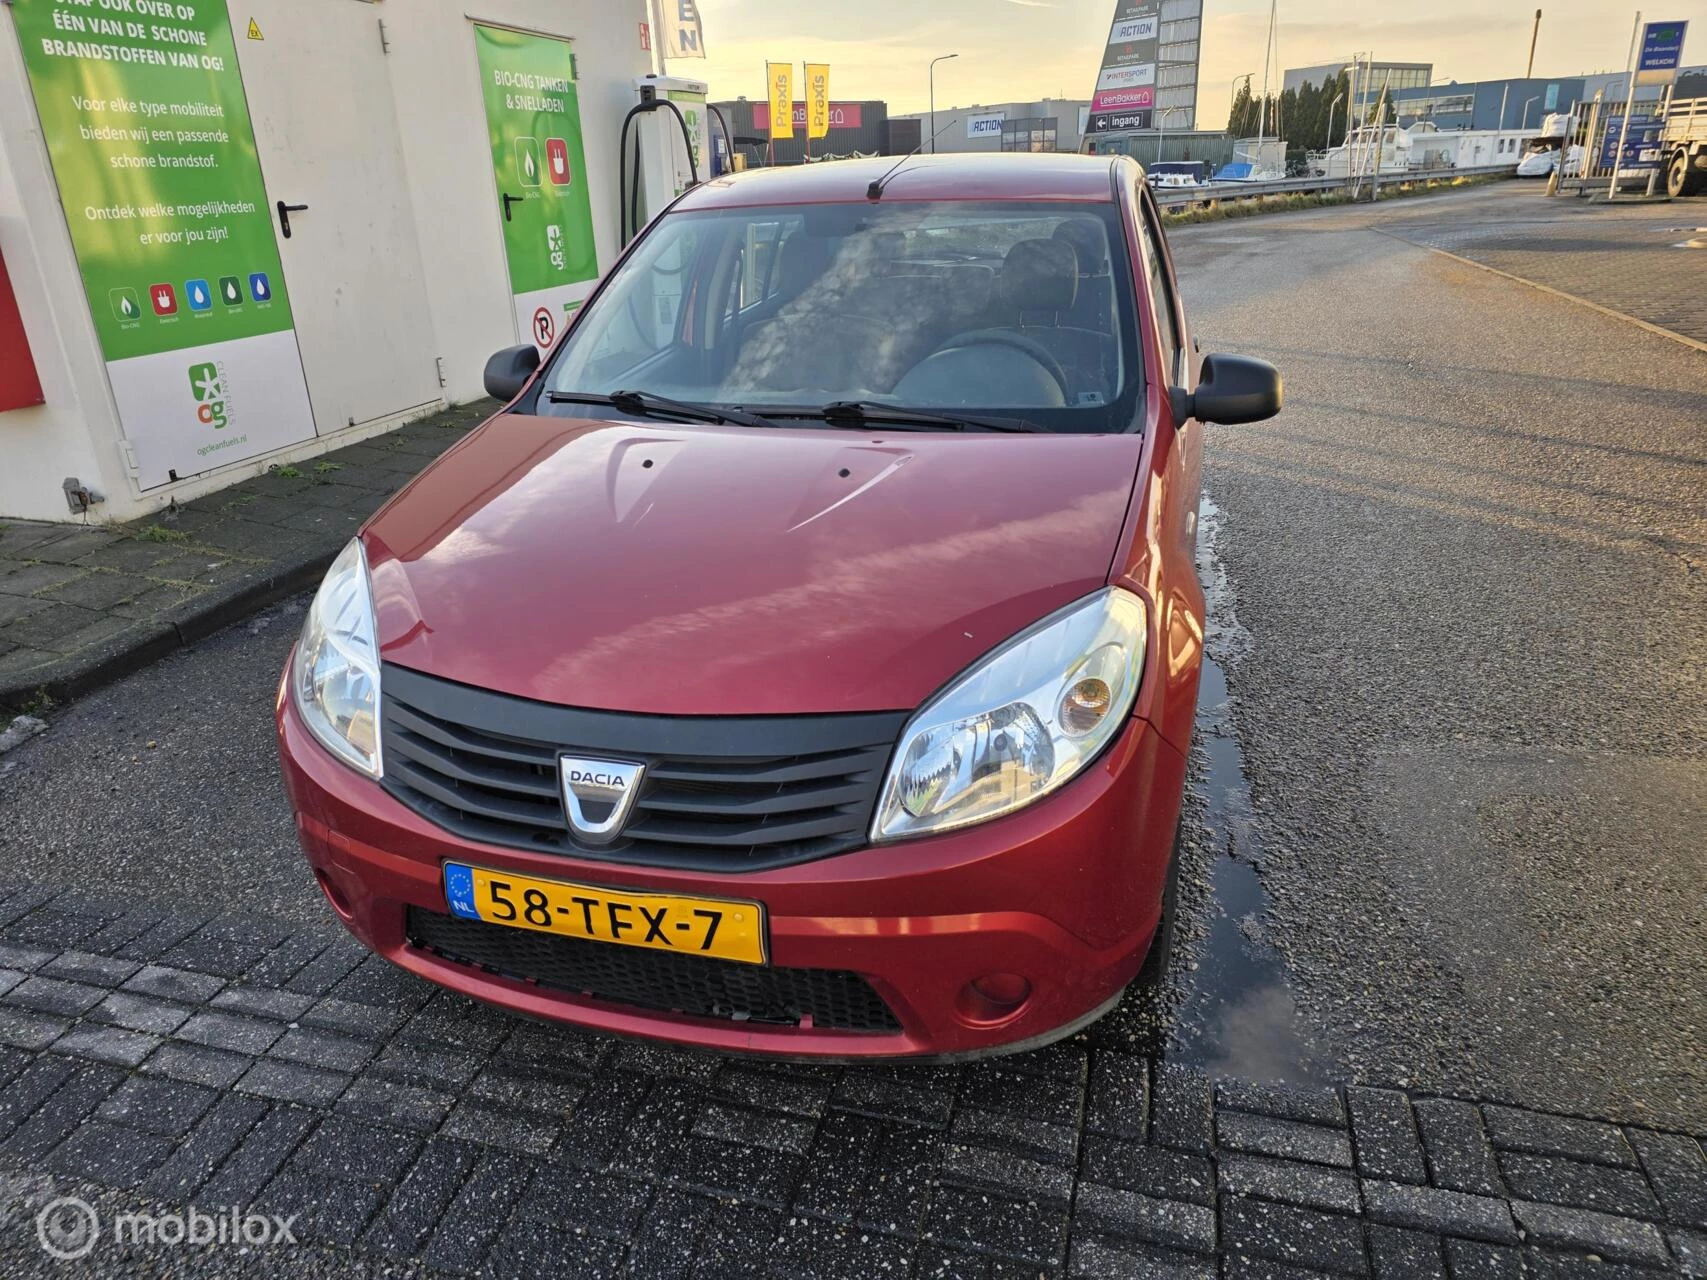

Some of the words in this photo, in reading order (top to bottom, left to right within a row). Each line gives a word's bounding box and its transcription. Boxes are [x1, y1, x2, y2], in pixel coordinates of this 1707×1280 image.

[136, 0, 175, 19] OVER
[177, 5, 195, 21] OP
[53, 9, 85, 32] ÉÉN
[89, 17, 124, 38] VAN
[126, 23, 147, 39] DE
[151, 27, 207, 46] SCHONE
[1120, 23, 1152, 37] ACTION
[41, 38, 166, 66] BRANDSTOFFEN
[168, 52, 198, 69] VAN
[201, 56, 224, 71] OG!
[494, 70, 534, 89] BIO-CNG
[534, 75, 568, 93] TANKEN
[1111, 69, 1147, 80] INTERSPORT
[71, 95, 106, 111] Voor
[110, 97, 137, 113] elke
[140, 100, 167, 117] type
[170, 102, 224, 117] mobiliteit
[506, 94, 514, 109] &
[515, 95, 564, 113] SNELLADEN
[776, 75, 787, 127] Praxis
[813, 75, 825, 127] Praxis
[1100, 94, 1141, 105] LeenBakker
[973, 119, 1003, 132] ACTION
[1112, 116, 1140, 127] ingang
[79, 125, 128, 140] bieden
[130, 127, 149, 144] wij
[152, 129, 174, 141] een
[177, 129, 229, 145] passende
[110, 153, 156, 168] schone
[159, 153, 218, 168] brandstof.
[84, 204, 136, 221] Ontdek
[138, 202, 174, 217] welke
[177, 200, 255, 219] mogelijkheden
[140, 233, 152, 245] er
[155, 230, 182, 243] voor
[185, 228, 203, 245] jou
[206, 226, 229, 243] zijn!
[196, 434, 248, 456] ogcleanfuels.nl
[570, 771, 625, 787] DACIA
[453, 900, 475, 913] NL
[489, 880, 723, 951] 58-TFX-7
